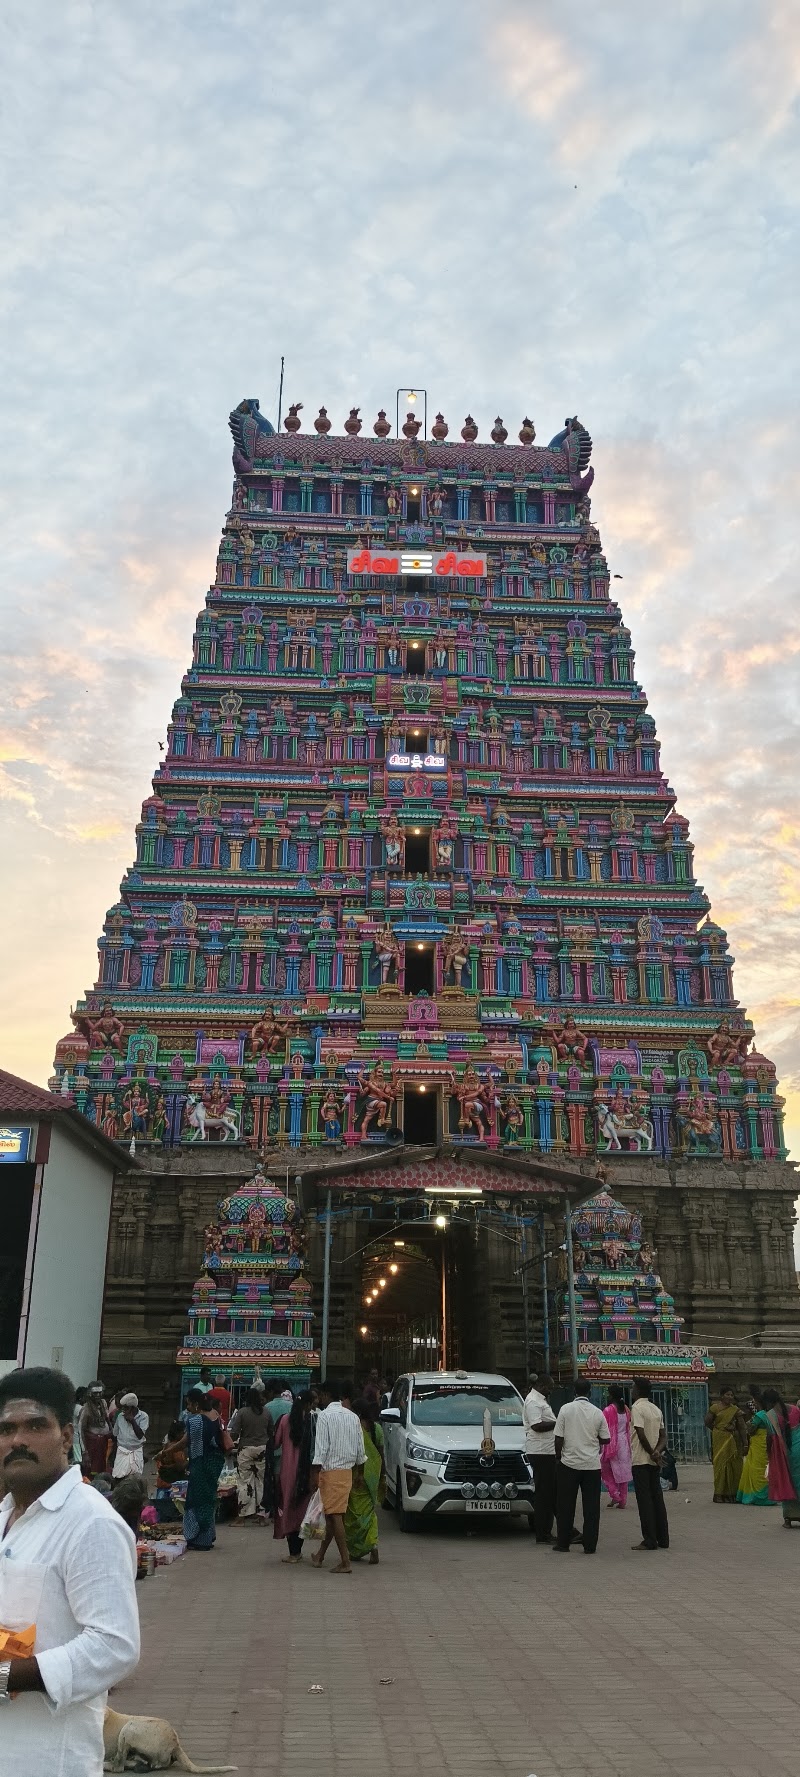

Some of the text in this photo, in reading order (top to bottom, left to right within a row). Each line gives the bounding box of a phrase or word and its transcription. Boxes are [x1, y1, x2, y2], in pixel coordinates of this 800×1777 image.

[350, 550, 484, 576] சிவ சிவ
[389, 754, 445, 767] சிவ சிவ
